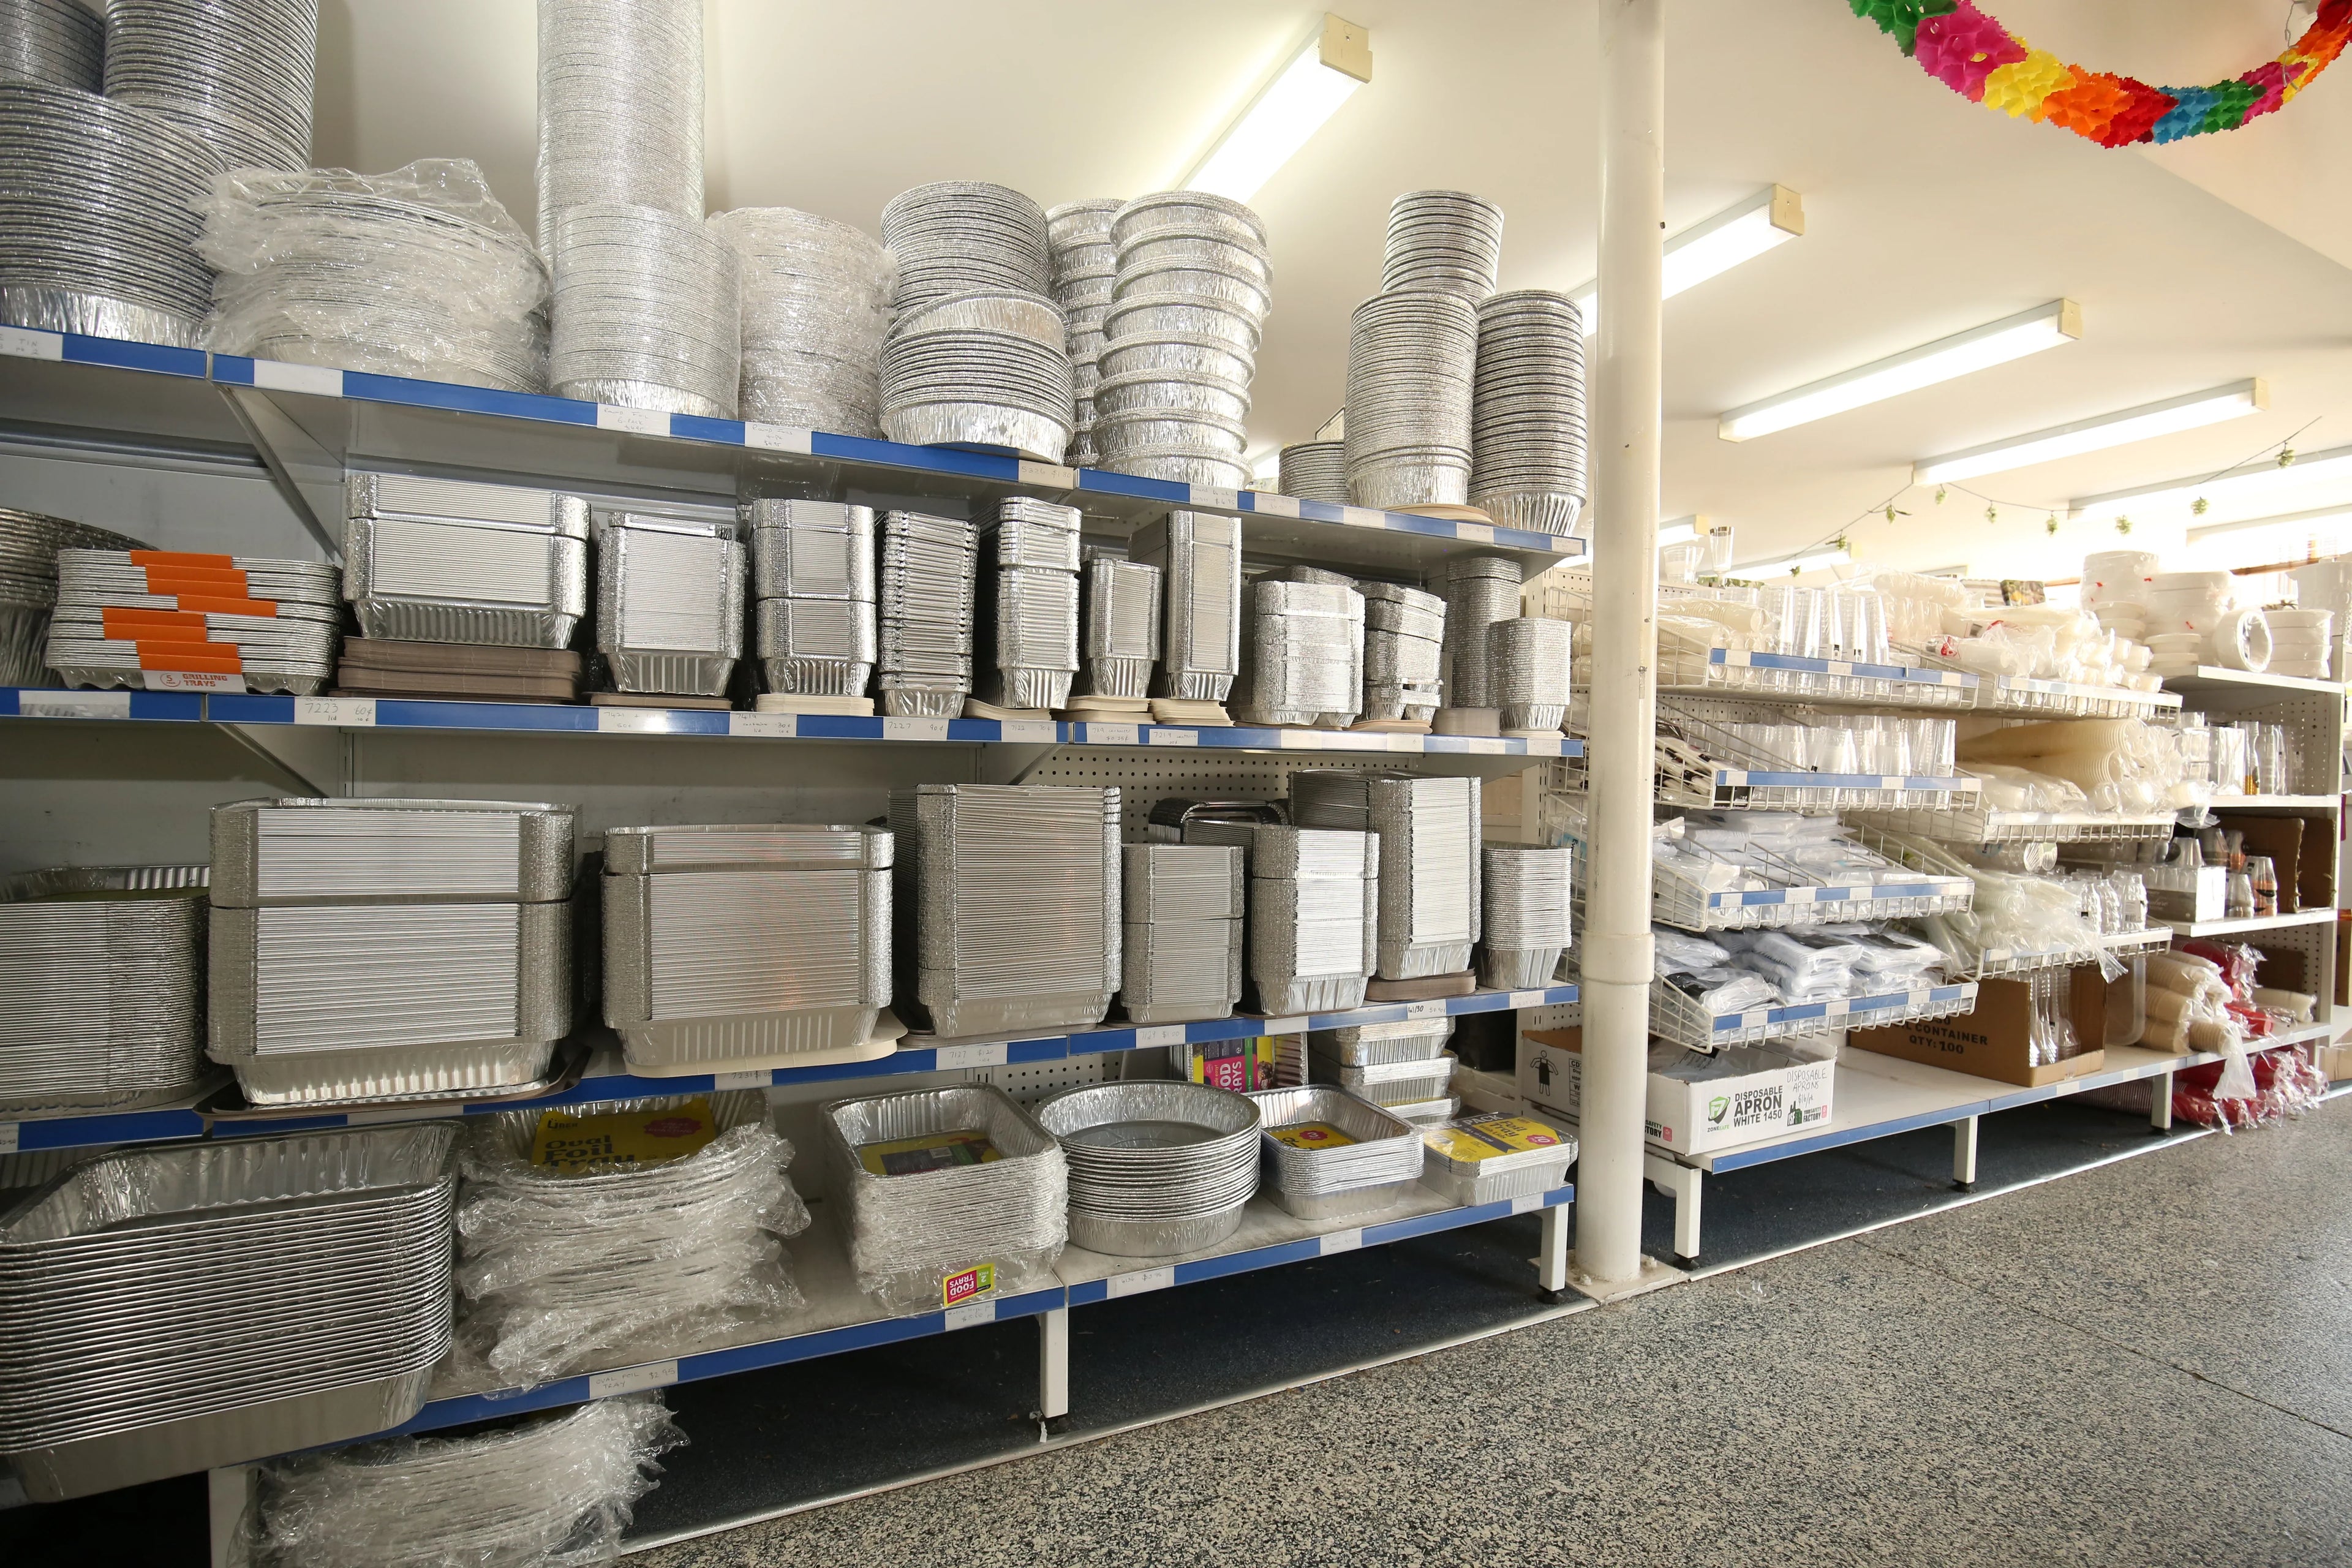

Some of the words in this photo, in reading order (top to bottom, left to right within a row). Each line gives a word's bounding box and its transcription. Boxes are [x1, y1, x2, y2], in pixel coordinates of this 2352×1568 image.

[1021, 466, 1046, 475] 5326
[305, 703, 339, 714] 7223
[888, 721, 911, 729] 7227
[1915, 1023, 1988, 1046] CONTAINER
[1909, 1035, 1937, 1049] QTY:
[1939, 1041, 1964, 1054] 100
[1219, 1063, 1232, 1091] OD
[1232, 1061, 1243, 1093] RAYS
[1735, 1084, 1784, 1102] DISPOSABLE
[1792, 1080, 1820, 1093] APRONS
[1733, 1094, 1782, 1118] APRON
[1462, 1114, 1504, 1126] PACK
[1733, 1113, 1762, 1128] WHITE
[1763, 1109, 1783, 1122] 1450
[1803, 1112, 1822, 1123] FACTORY
[1489, 1121, 1520, 1137] Tray
[1499, 1120, 1529, 1132] Foil
[545, 1134, 611, 1150] Oval
[545, 1143, 615, 1161] Foil
[949, 1274, 974, 1288] TRAYS
[981, 1275, 987, 1283] 2
[949, 1280, 974, 1296] FOOD
[595, 1376, 618, 1385] OVAL
[603, 1380, 626, 1390] TRAY
